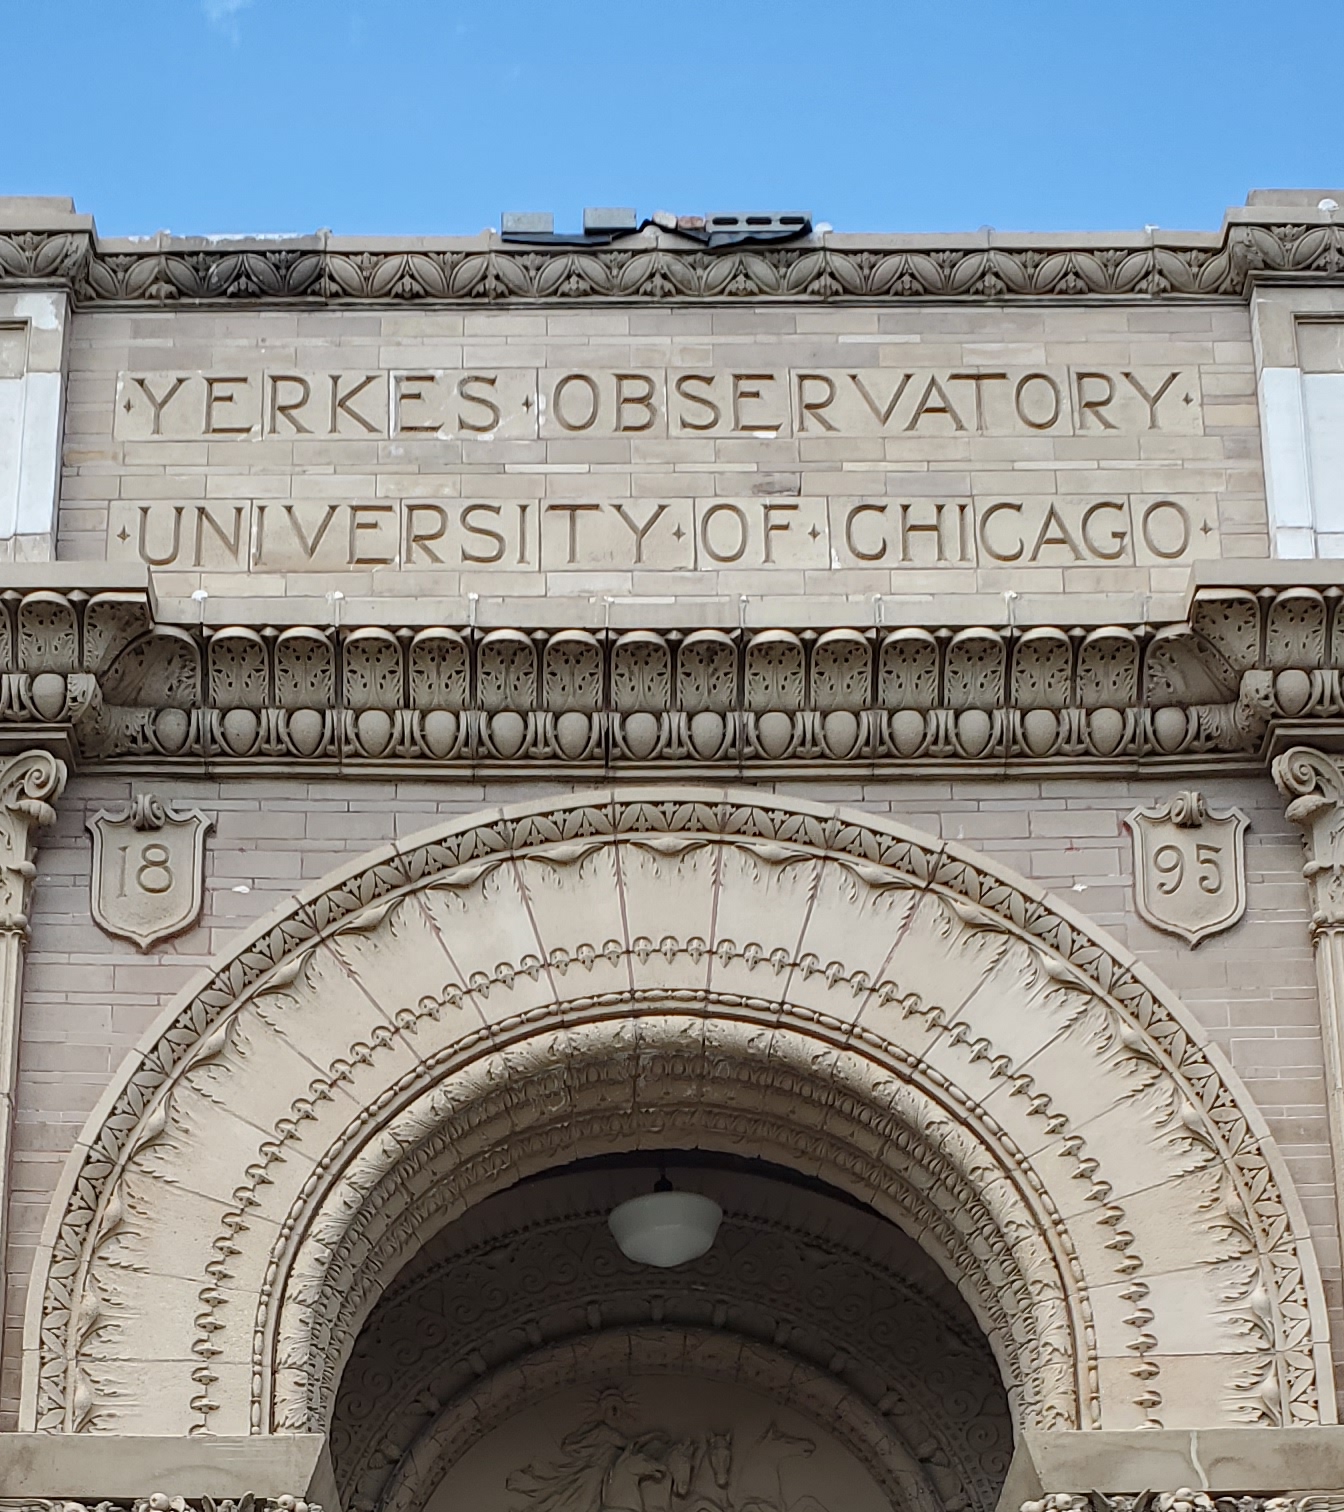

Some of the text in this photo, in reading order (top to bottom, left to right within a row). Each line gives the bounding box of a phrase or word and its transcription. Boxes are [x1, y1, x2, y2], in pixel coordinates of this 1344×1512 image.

[130, 371, 1183, 436] YERKES OBSERVATORY
[137, 501, 1191, 567] UNIVERSITY OF CHICAGO
[115, 842, 174, 899] 18
[1152, 842, 1223, 896] 95
